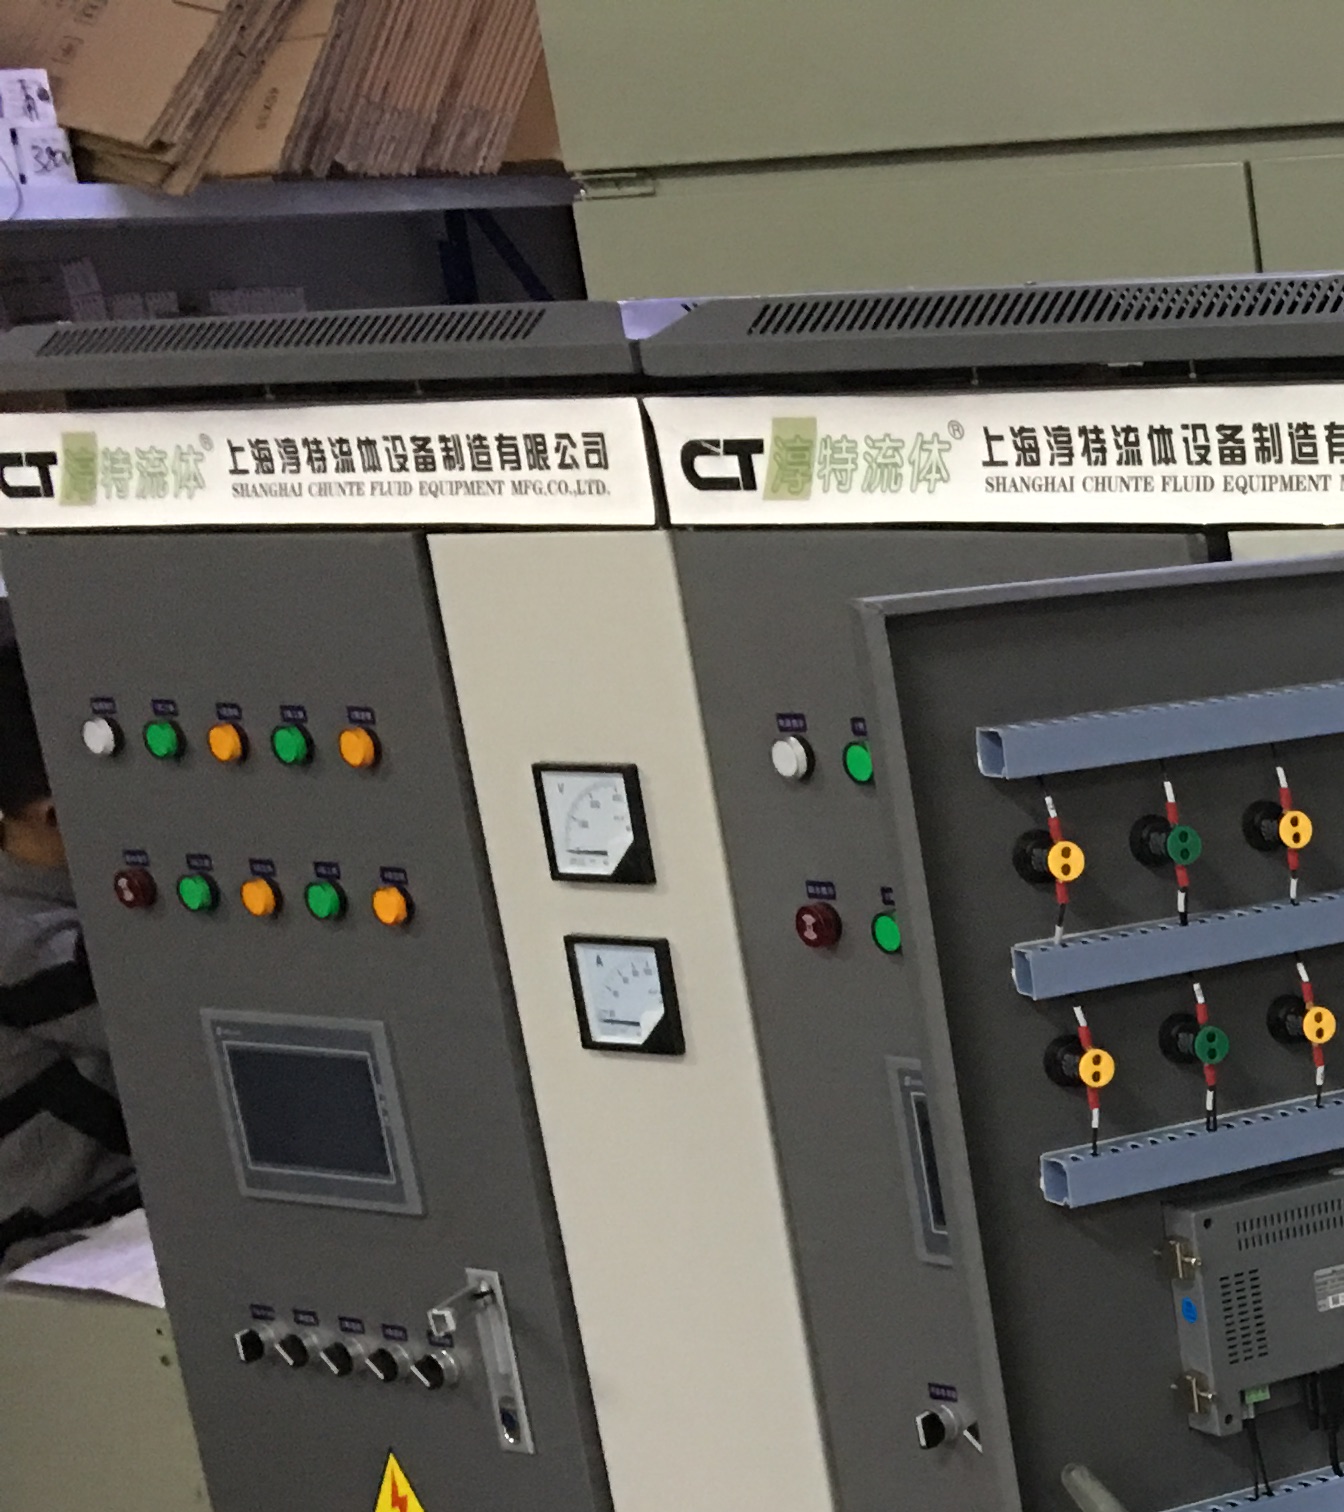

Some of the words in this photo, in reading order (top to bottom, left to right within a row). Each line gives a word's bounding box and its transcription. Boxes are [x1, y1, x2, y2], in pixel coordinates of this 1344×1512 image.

[227, 432, 609, 475] 上海淳特流体设备制造有限公司
[680, 438, 764, 491] CT
[771, 431, 952, 494] 淳特流体
[232, 483, 302, 498] SHANGHAI
[308, 482, 365, 497] CHUNTE
[370, 481, 412, 496] FLUID
[419, 480, 504, 498] EQUIPMENT
[985, 476, 1075, 494] SHANGHAI
[1082, 475, 1155, 493] CHUNTE
[1161, 475, 1215, 493] FLUID
[1222, 474, 1332, 494] EQUIPMENT
